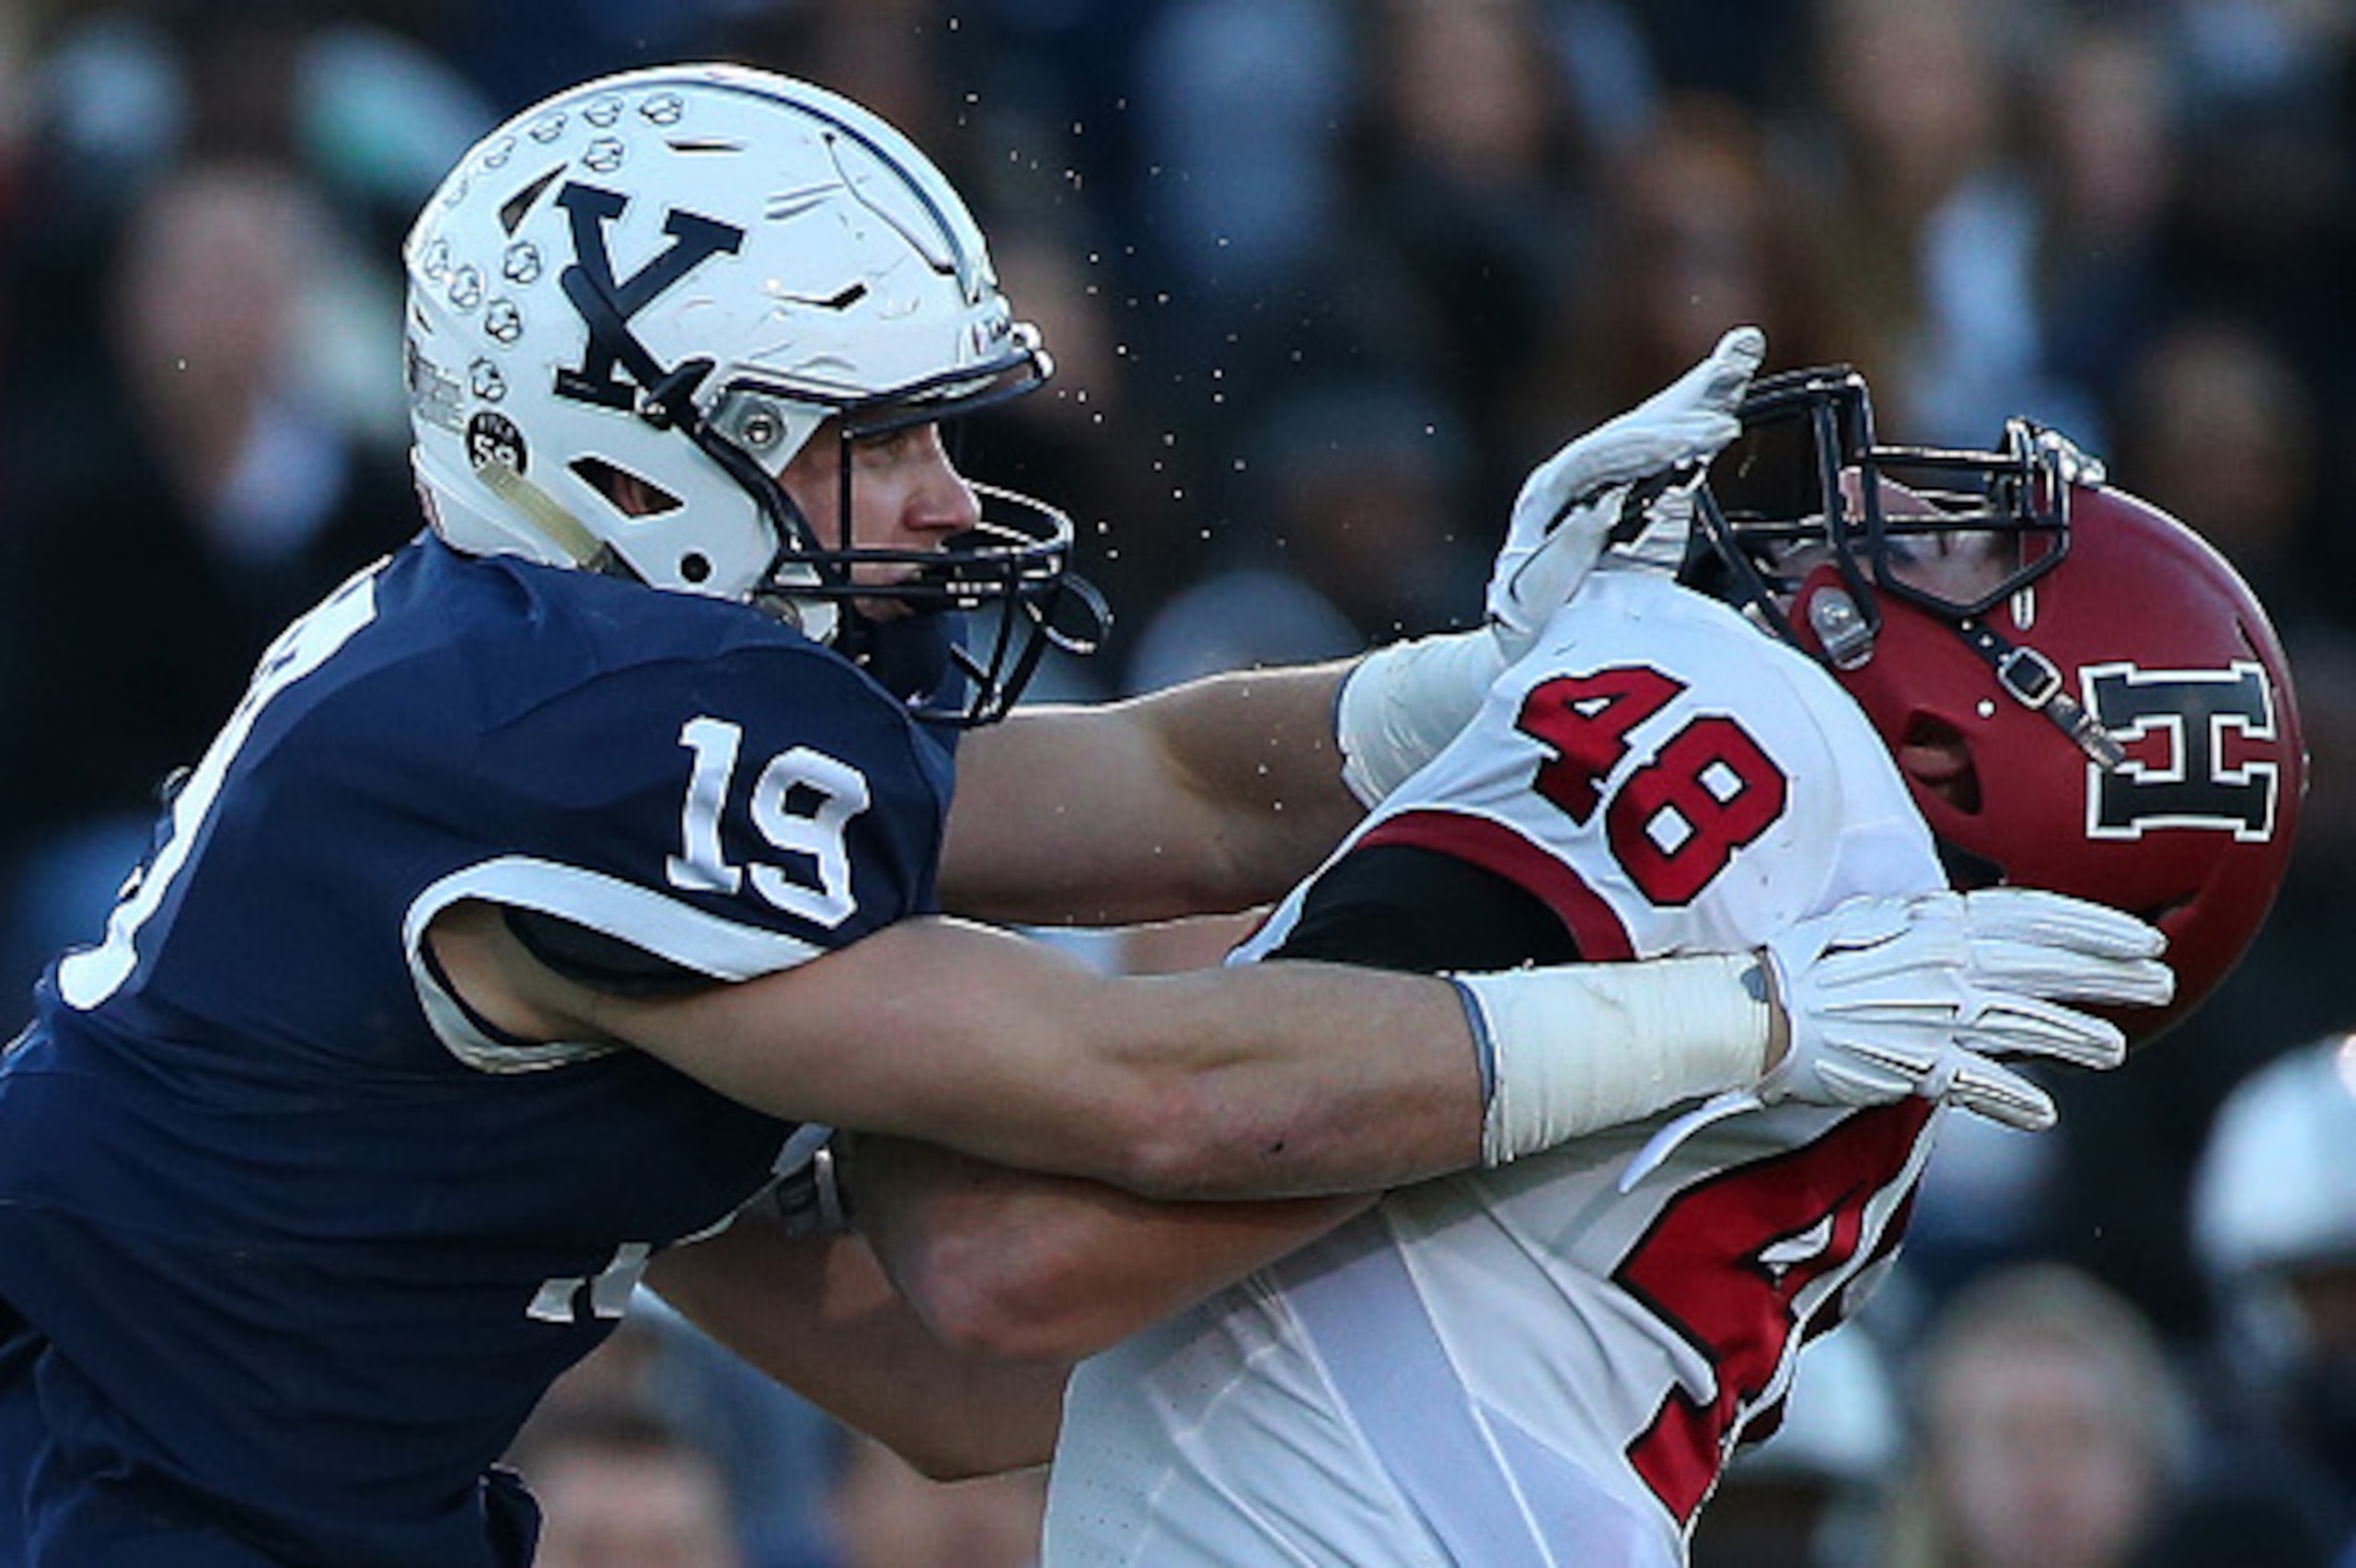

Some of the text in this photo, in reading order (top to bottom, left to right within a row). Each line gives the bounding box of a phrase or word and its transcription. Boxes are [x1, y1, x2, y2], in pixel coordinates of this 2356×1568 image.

[666, 715, 871, 928] 19
[1515, 664, 1788, 907] 48
[2079, 661, 2279, 842] H
